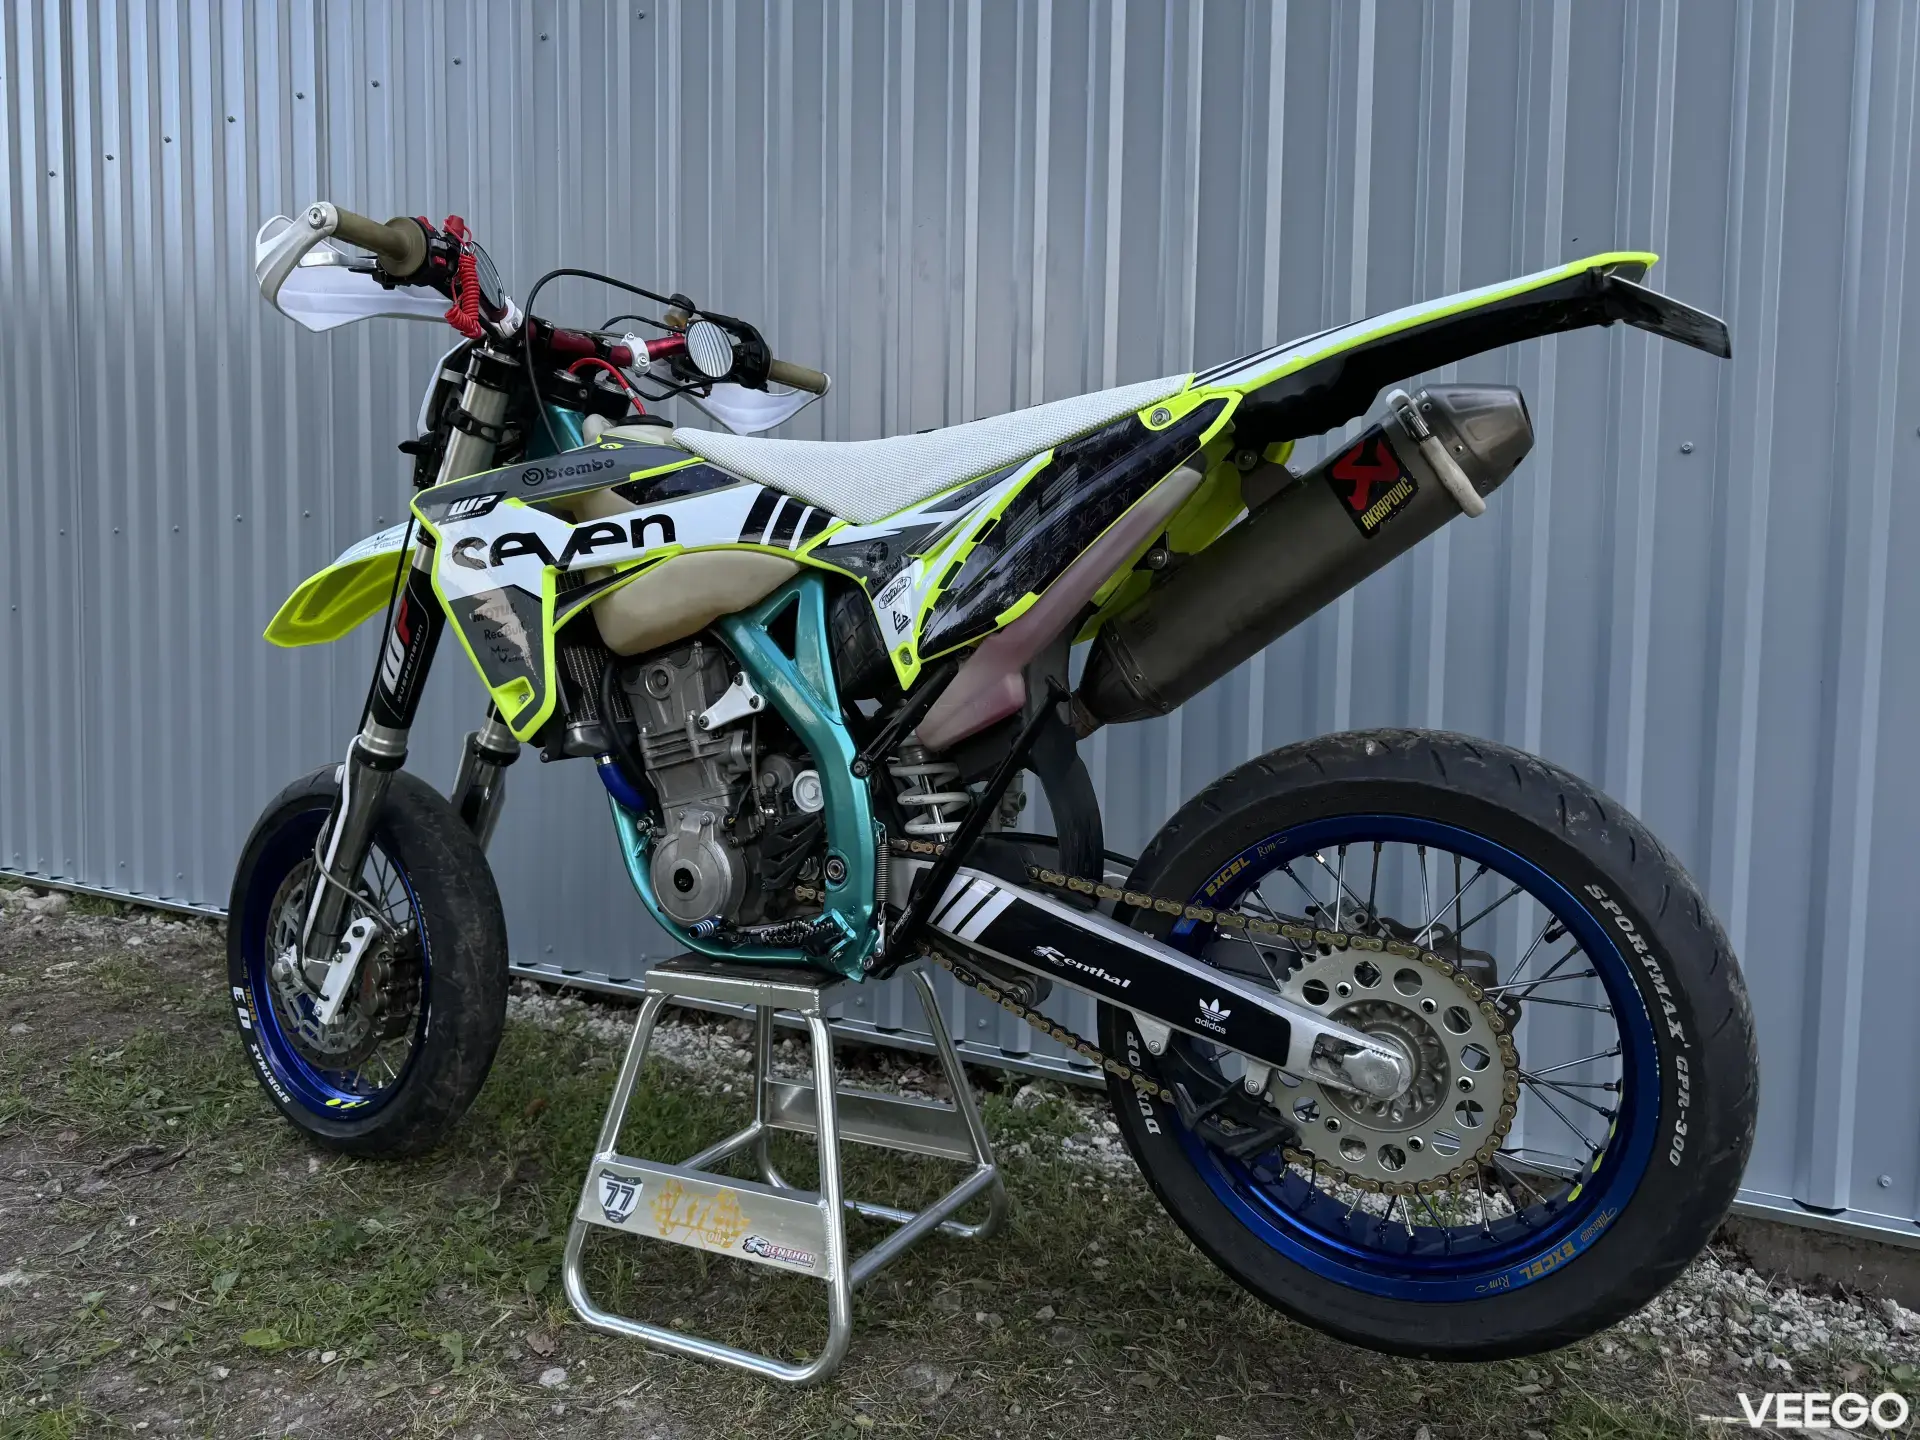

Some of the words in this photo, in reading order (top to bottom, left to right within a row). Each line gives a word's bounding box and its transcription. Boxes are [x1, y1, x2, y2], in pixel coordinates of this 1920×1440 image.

[545, 457, 615, 481] brembo
[448, 494, 498, 517] WP
[1204, 857, 1251, 897] EXCEL
[1584, 884, 1687, 1042] SPORTMAX
[1194, 1014, 1227, 1035] adidas
[250, 1043, 291, 1104] SPORTMAX
[1126, 1030, 1162, 1135] DUNOP
[1668, 1054, 1691, 1168] GPR-300
[606, 1181, 636, 1212] 77
[763, 1244, 816, 1263] RENTHAL
[1519, 1241, 1577, 1280] EXCEL
